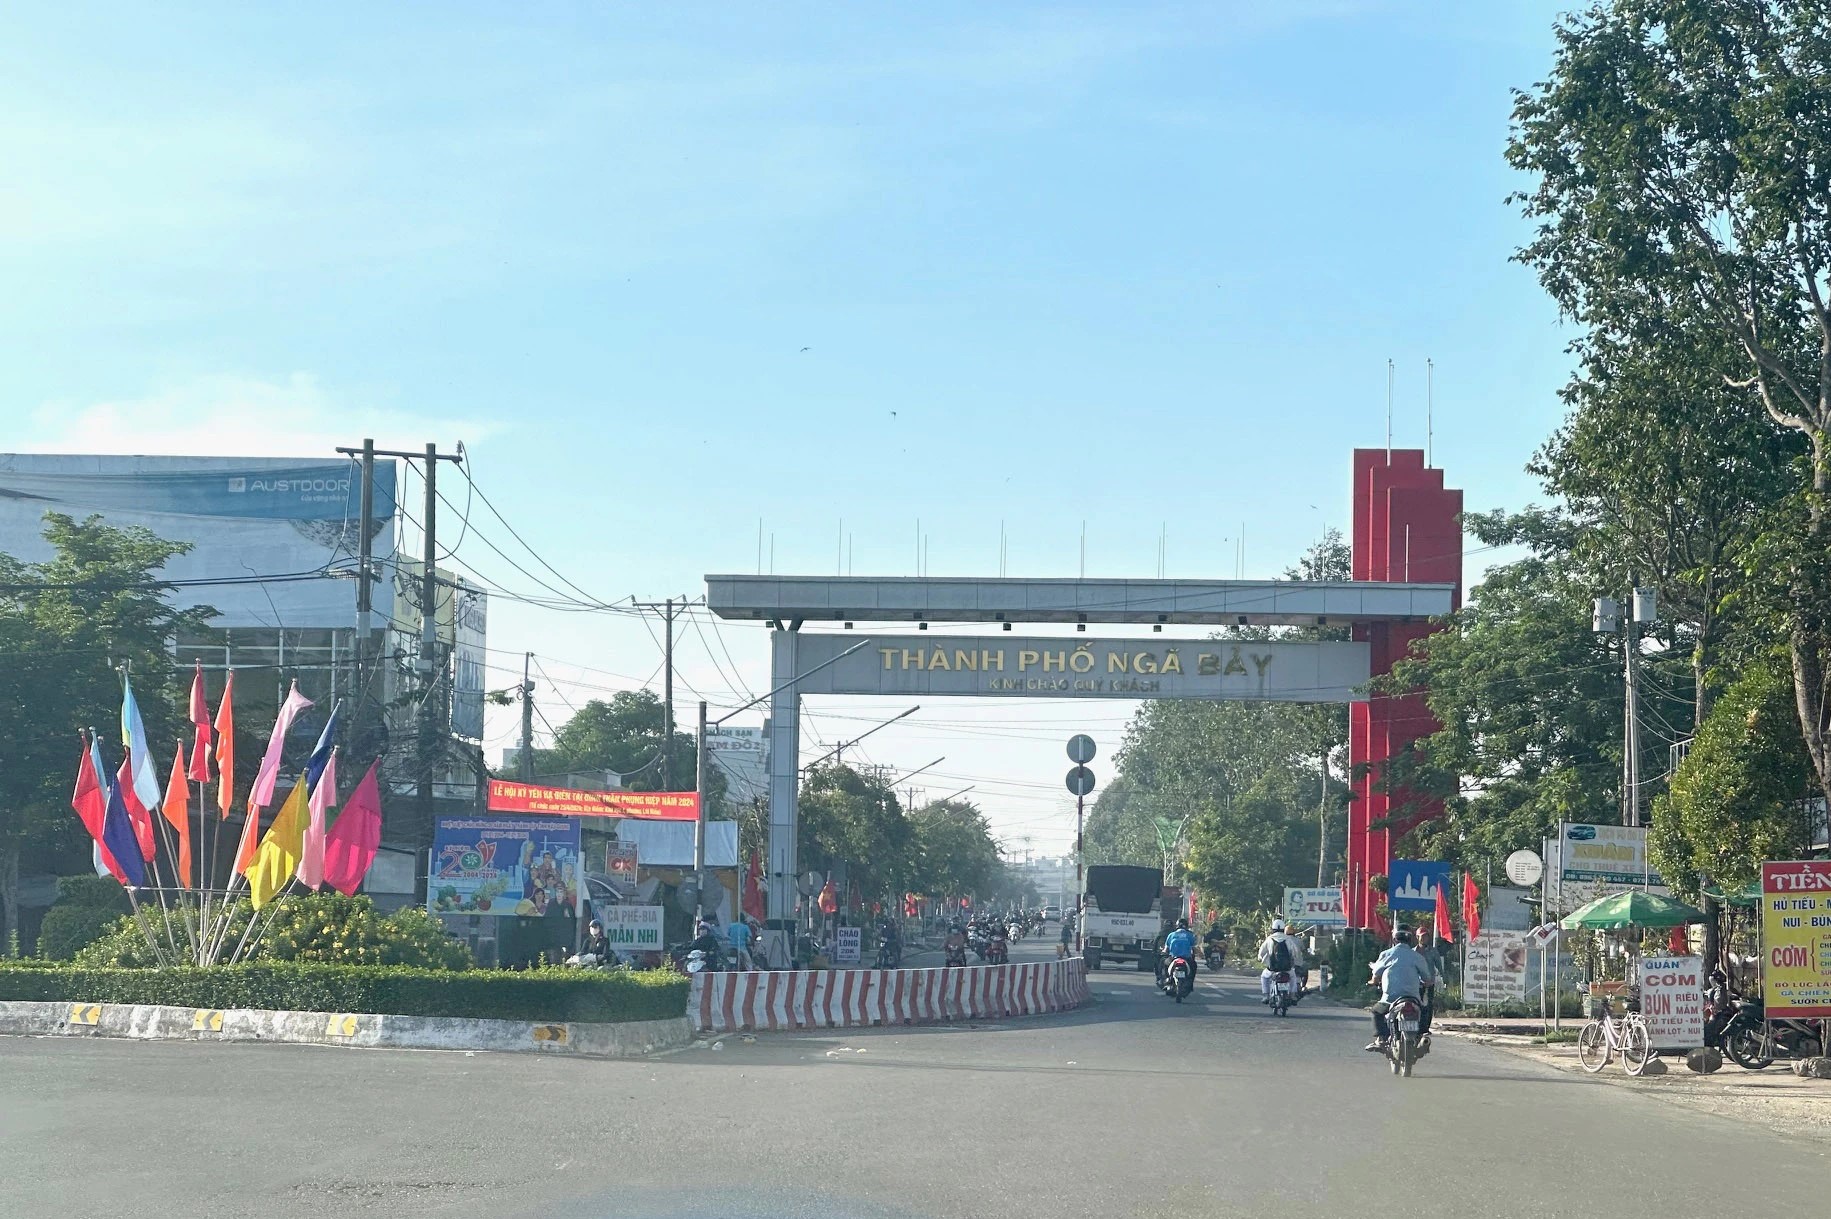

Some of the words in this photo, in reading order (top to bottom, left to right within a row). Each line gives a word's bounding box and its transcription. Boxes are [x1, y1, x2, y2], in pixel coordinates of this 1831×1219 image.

[250, 479, 349, 492] AUSTDOOR
[878, 643, 1004, 671] THÀNH
[1018, 641, 1094, 674] PHỐ
[1107, 648, 1184, 675] NGÃ
[1198, 646, 1273, 676] BẢY
[1027, 675, 1069, 691] CHÀO
[1073, 676, 1104, 692] QUÝ
[1110, 676, 1160, 693] KHÁCH
[494, 784, 503, 796] LỄ
[504, 786, 516, 799] HỘI
[661, 795, 677, 807] NĂM
[678, 797, 695, 807] 2024
[1306, 898, 1343, 912] TUẤ
[1773, 896, 1787, 910] HỦ
[1792, 896, 1815, 910] TIẾU
[608, 907, 619, 922] CÀ
[1783, 917, 1800, 928] NUI
[638, 929, 657, 943] NHI
[1771, 944, 1808, 968] CƠM
[1645, 958, 1680, 969] QUÁN
[1645, 972, 1696, 986] CƠM
[1644, 988, 1671, 1015] BÚN
[1675, 991, 1699, 1002] RIÊU
[1675, 1004, 1699, 1015] MẮM
[1661, 1015, 1683, 1025] TIẾU
[1667, 1027, 1681, 1038] LỌT
[1688, 1027, 1701, 1035] NUI
